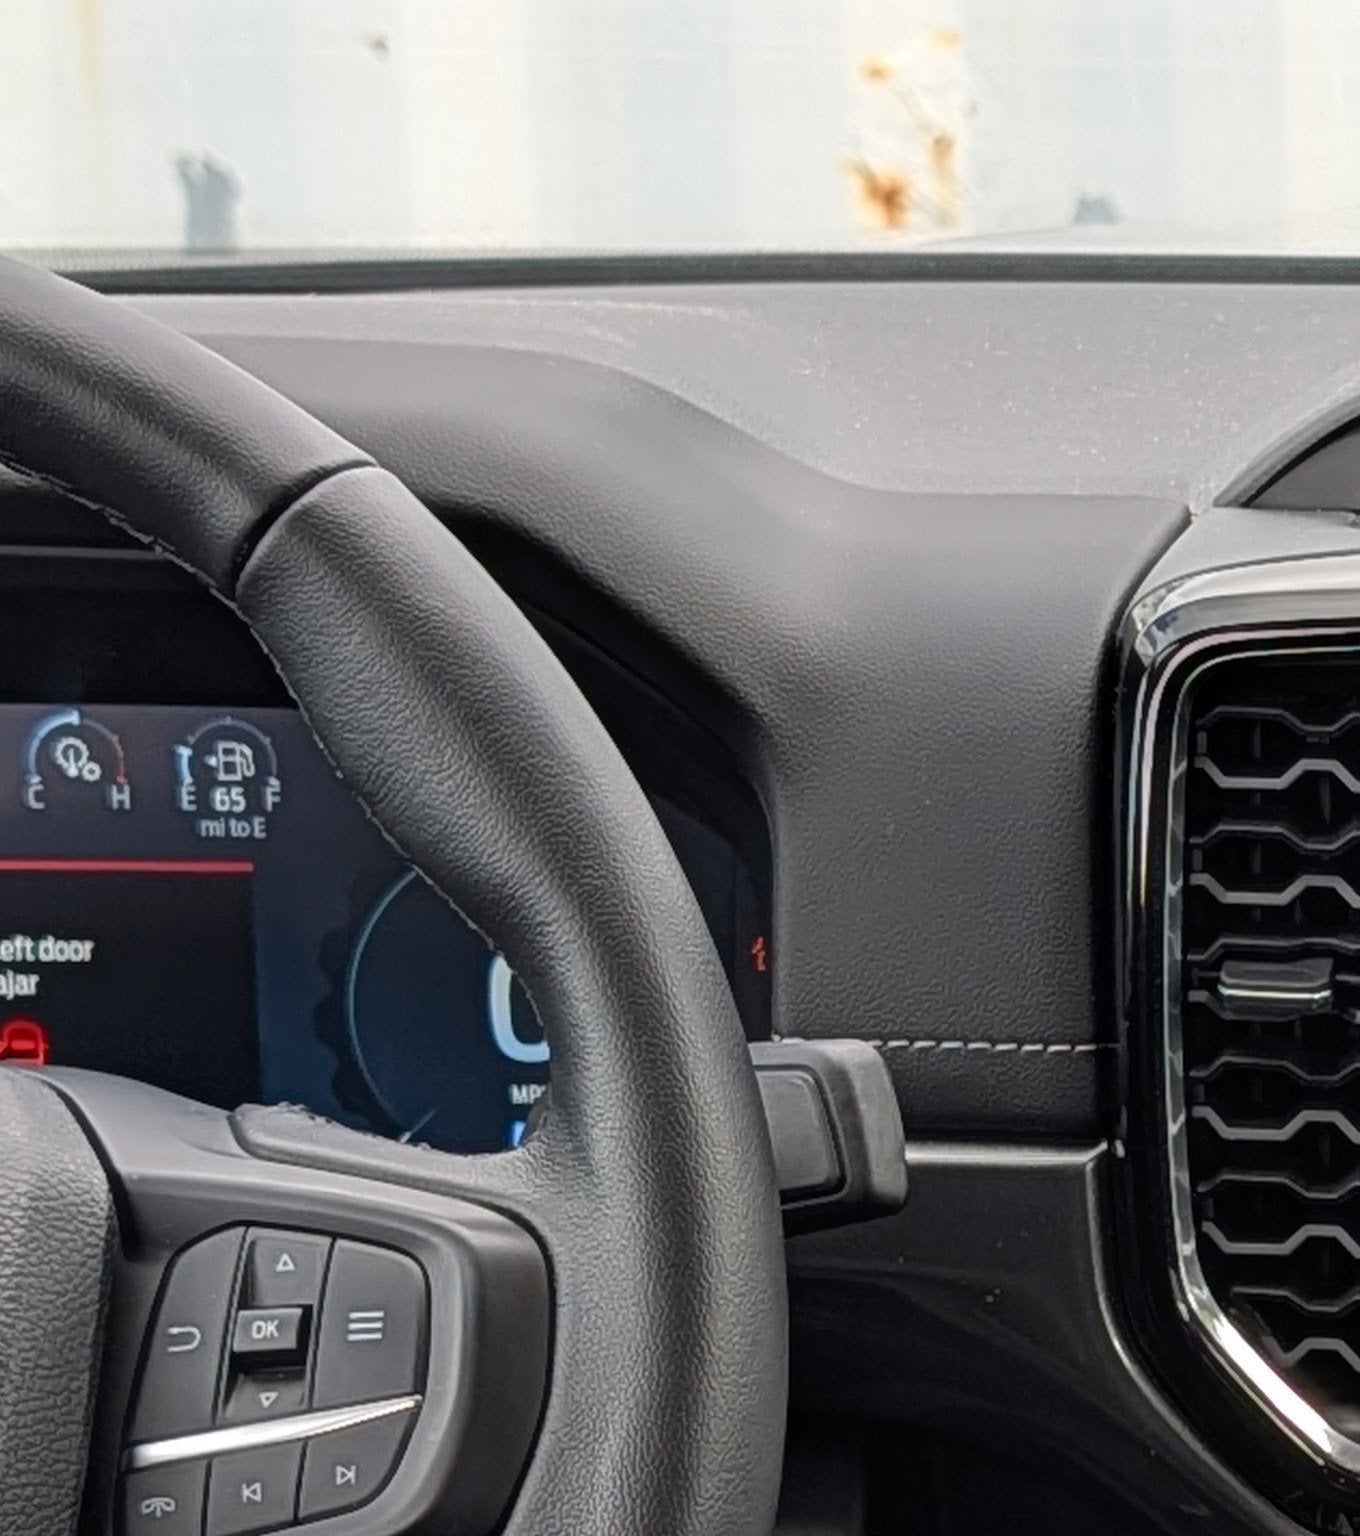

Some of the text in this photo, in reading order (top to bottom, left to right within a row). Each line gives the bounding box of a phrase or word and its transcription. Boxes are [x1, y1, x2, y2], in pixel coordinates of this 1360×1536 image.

[26, 784, 46, 811] C
[110, 784, 132, 811] H
[180, 784, 198, 811] E
[213, 786, 247, 812] 65
[265, 784, 281, 811] F
[200, 817, 267, 838] mi to E
[38, 935, 96, 963] door
[0, 969, 40, 1003] ajar
[510, 1082, 547, 1106] MP
[251, 1319, 280, 1339] OK
